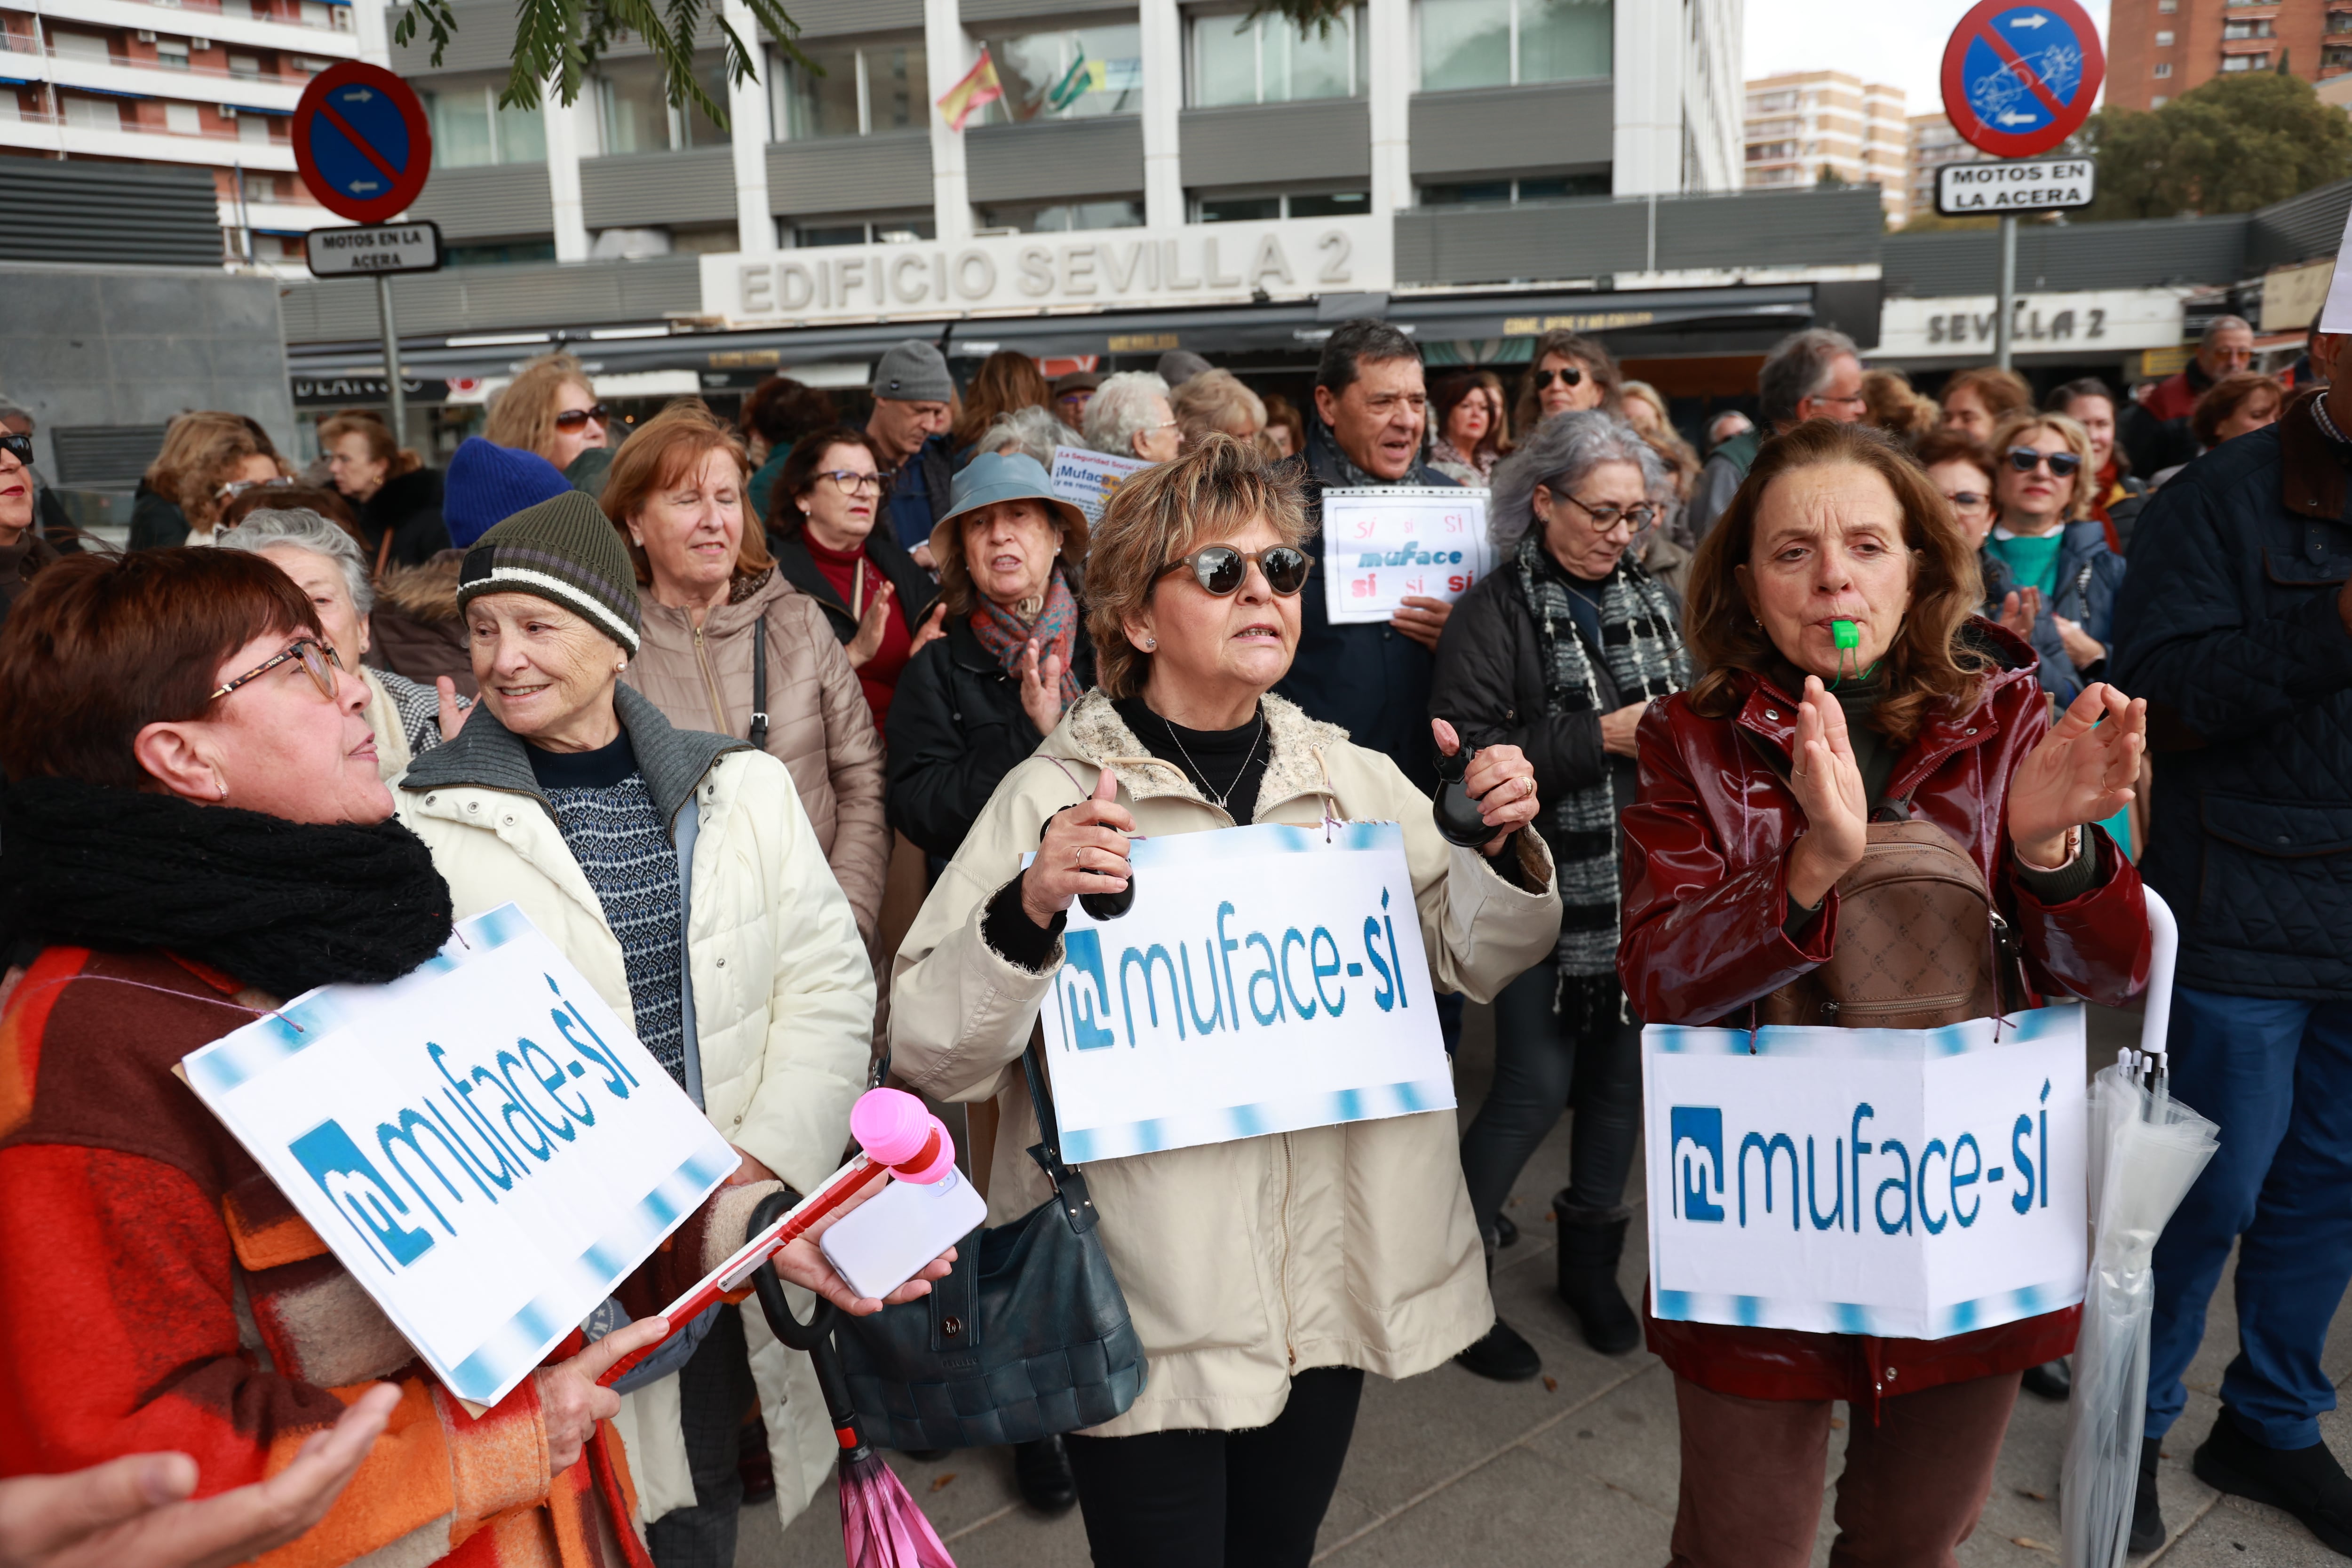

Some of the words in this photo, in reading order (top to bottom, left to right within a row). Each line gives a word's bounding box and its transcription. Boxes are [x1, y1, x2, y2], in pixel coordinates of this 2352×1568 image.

[1953, 166, 2042, 183] MOTOS
[2052, 165, 2085, 179] EN
[1956, 192, 1986, 207] LA
[1995, 187, 2080, 206] ACERA
[323, 233, 374, 249] MOTOS
[379, 231, 399, 246] EN
[403, 230, 422, 244] LA
[352, 253, 402, 268] ACERA
[739, 249, 997, 314] EDIFICIO
[1017, 233, 1294, 297] SEVILLA
[1319, 230, 1351, 283] 2
[1929, 310, 2075, 343] SEVLLA
[2086, 309, 2106, 338] 2
[1072, 453, 1109, 464] Seguridad
[1056, 465, 1110, 484] ¡Muface
[1358, 541, 1462, 567] muface
[267, 655, 284, 666] TOUS
[1119, 884, 1408, 1048] muface-sí
[375, 972, 640, 1237] muface-sí
[1738, 1077, 2051, 1236] muface-sí
